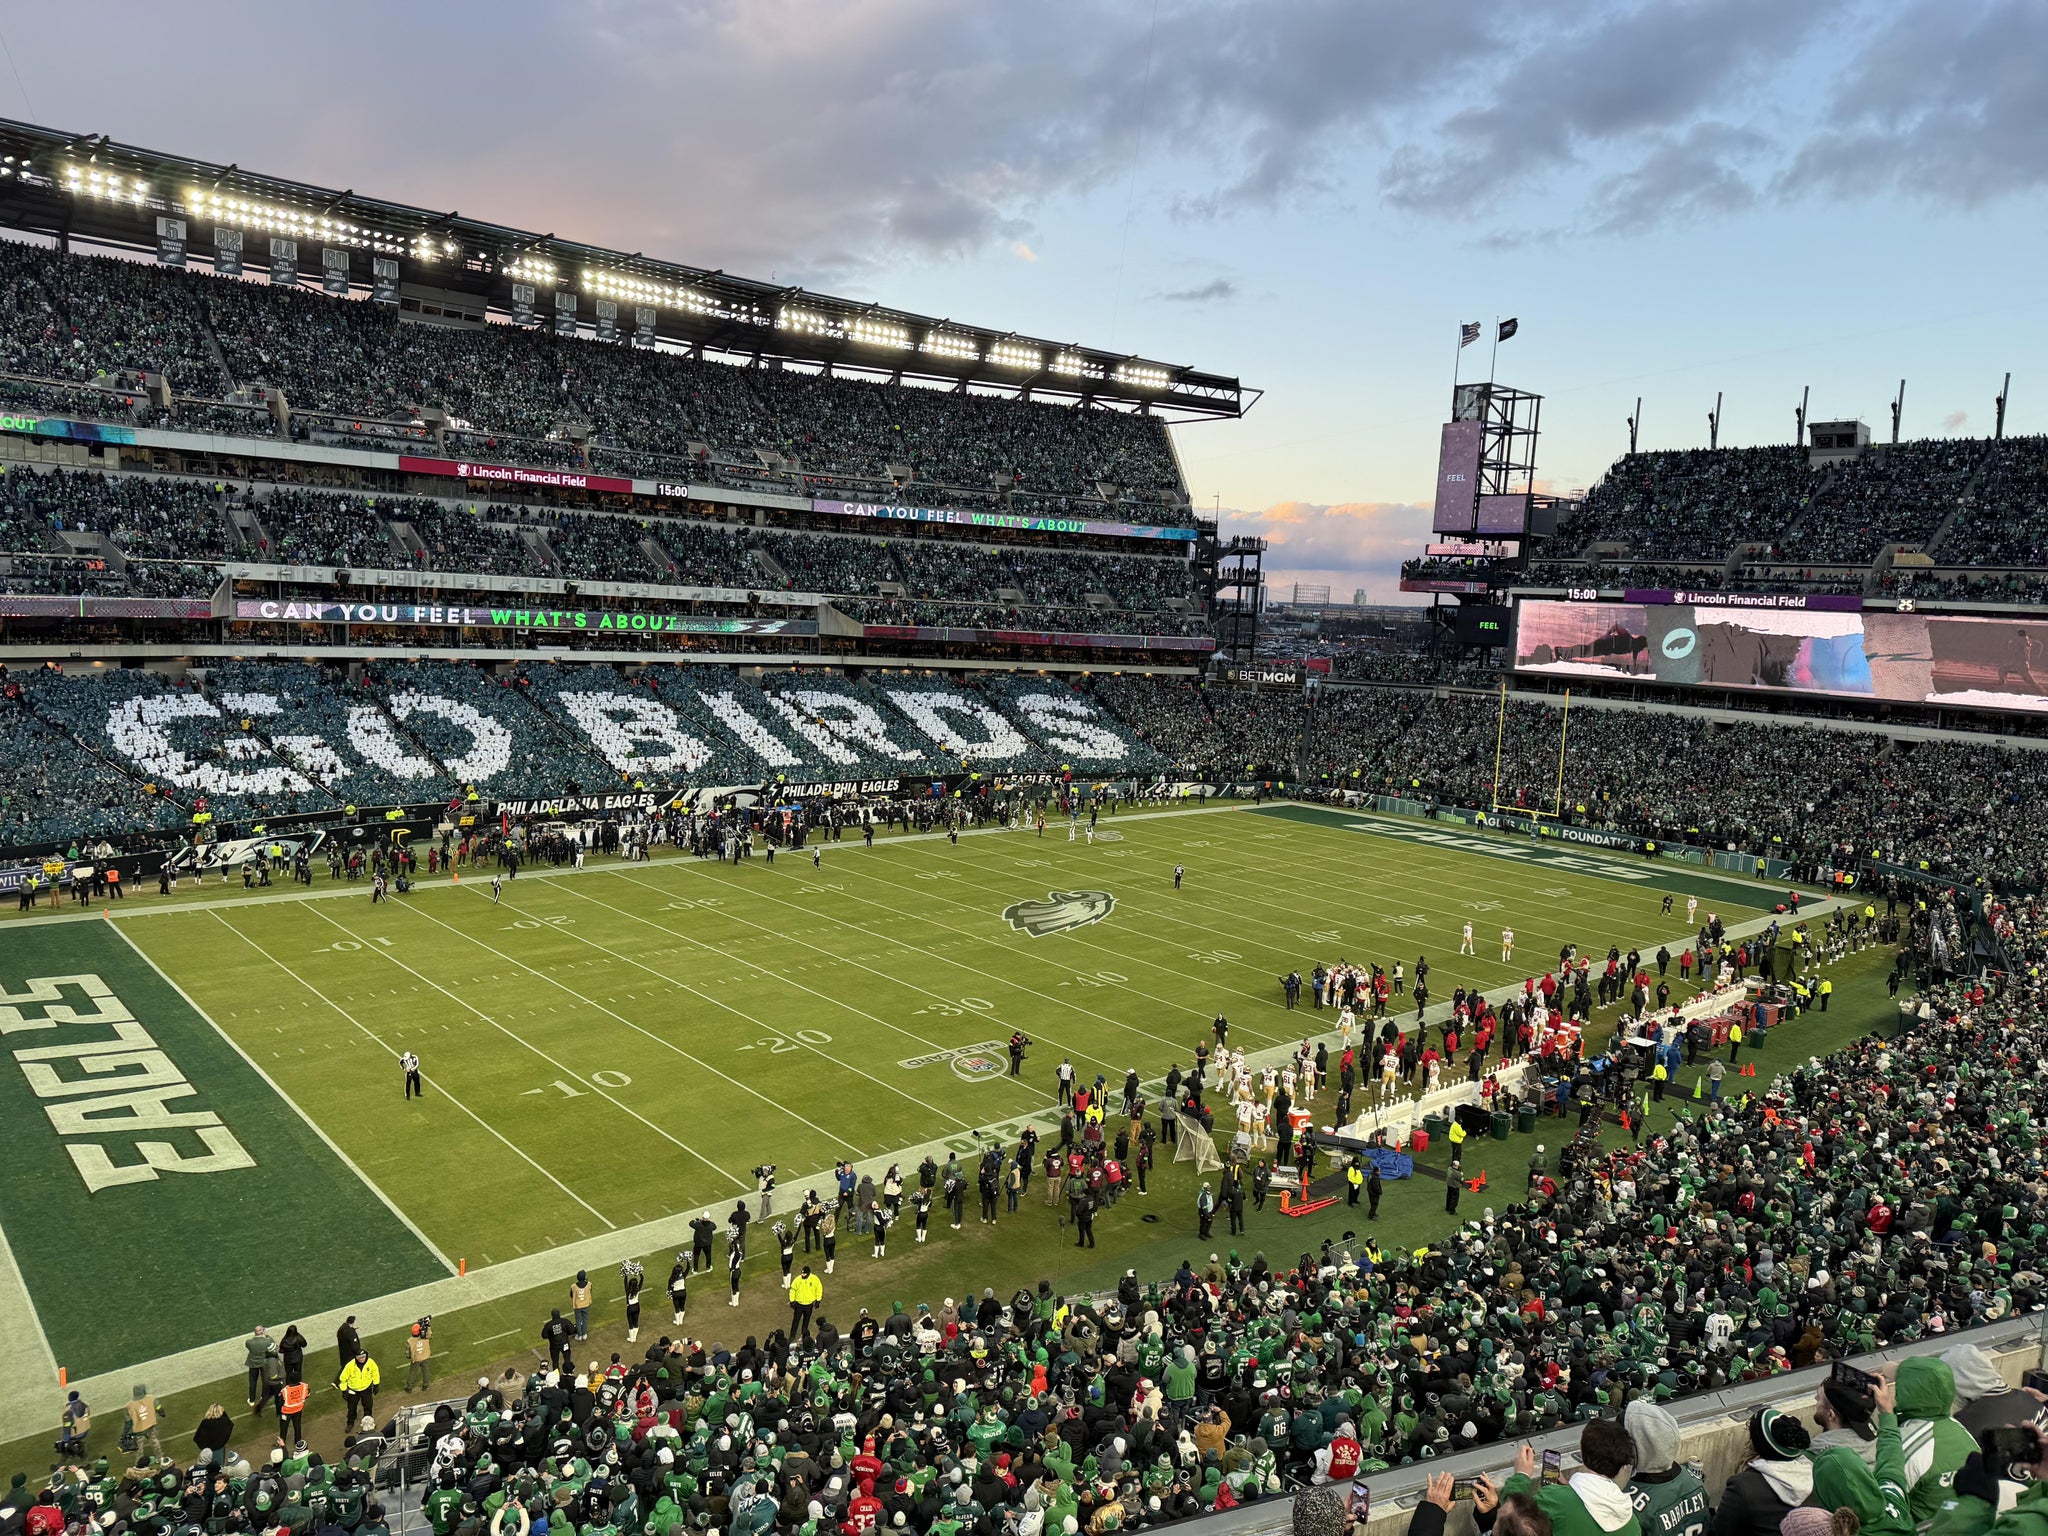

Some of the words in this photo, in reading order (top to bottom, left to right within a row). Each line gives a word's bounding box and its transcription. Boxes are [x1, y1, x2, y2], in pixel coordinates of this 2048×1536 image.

[165, 219, 179, 240] 5
[217, 229, 241, 252] 92
[272, 240, 295, 262] 44
[324, 249, 348, 271] 60
[375, 258, 397, 280] 70
[514, 285, 533, 305] 15
[557, 293, 575, 312] 40
[598, 301, 615, 320] 99
[637, 308, 654, 327] 20
[0, 416, 36, 431] OUT
[472, 465, 512, 480] Lincoln
[514, 469, 560, 485] Financial
[562, 475, 586, 487] Field
[1446, 474, 1465, 482] FEEL
[659, 484, 688, 498] 15:00
[843, 503, 877, 517] CAN
[886, 506, 918, 520] YOU
[927, 509, 963, 524] FEEL
[971, 513, 1029, 528] WHAT'S
[1037, 517, 1087, 533] ABOUT
[1567, 588, 1597, 600] 15:00
[1688, 592, 1725, 604] Lincoln
[1728, 595, 1777, 607] Financial
[1779, 596, 1806, 608] Field
[1899, 599, 1914, 611] 25
[260, 602, 322, 619] CAN
[340, 604, 398, 622] YOU
[414, 606, 476, 624] FEEL
[490, 609, 586, 628] WHAT'S
[600, 613, 677, 631] ABOUT
[1479, 621, 1499, 630] FEEL
[1239, 670, 1296, 683] BETMGM
[106, 688, 512, 796] GO
[559, 690, 1129, 782] BIRDS
[1010, 774, 1052, 784] EAGLES
[781, 782, 857, 798] PHILADELPHIA
[861, 779, 899, 793] EAGLES
[496, 796, 599, 816] PHILADELPHIA
[604, 794, 655, 810] EAGLES
[1343, 822, 1669, 880] EAGLES
[667, 898, 724, 910] 30
[513, 915, 576, 929] 20
[331, 936, 398, 951] 10
[1187, 949, 1243, 964] 50
[1073, 971, 1129, 988] 40
[927, 996, 995, 1018] 30
[757, 1028, 833, 1054] 20
[958, 1041, 1000, 1055] WILD
[907, 1052, 958, 1066] CARD
[961, 1058, 986, 1067] NFL
[0, 974, 257, 1193] EAGLES
[548, 1070, 633, 1100] 10
[1717, 1325, 1728, 1336] 11
[1145, 1354, 1160, 1367] 62
[1273, 1421, 1286, 1436] 86
[85, 1491, 103, 1505] 98
[1628, 1485, 1650, 1513] 26
[338, 1503, 346, 1515] 1
[1659, 1490, 1706, 1531] BARKLEY
